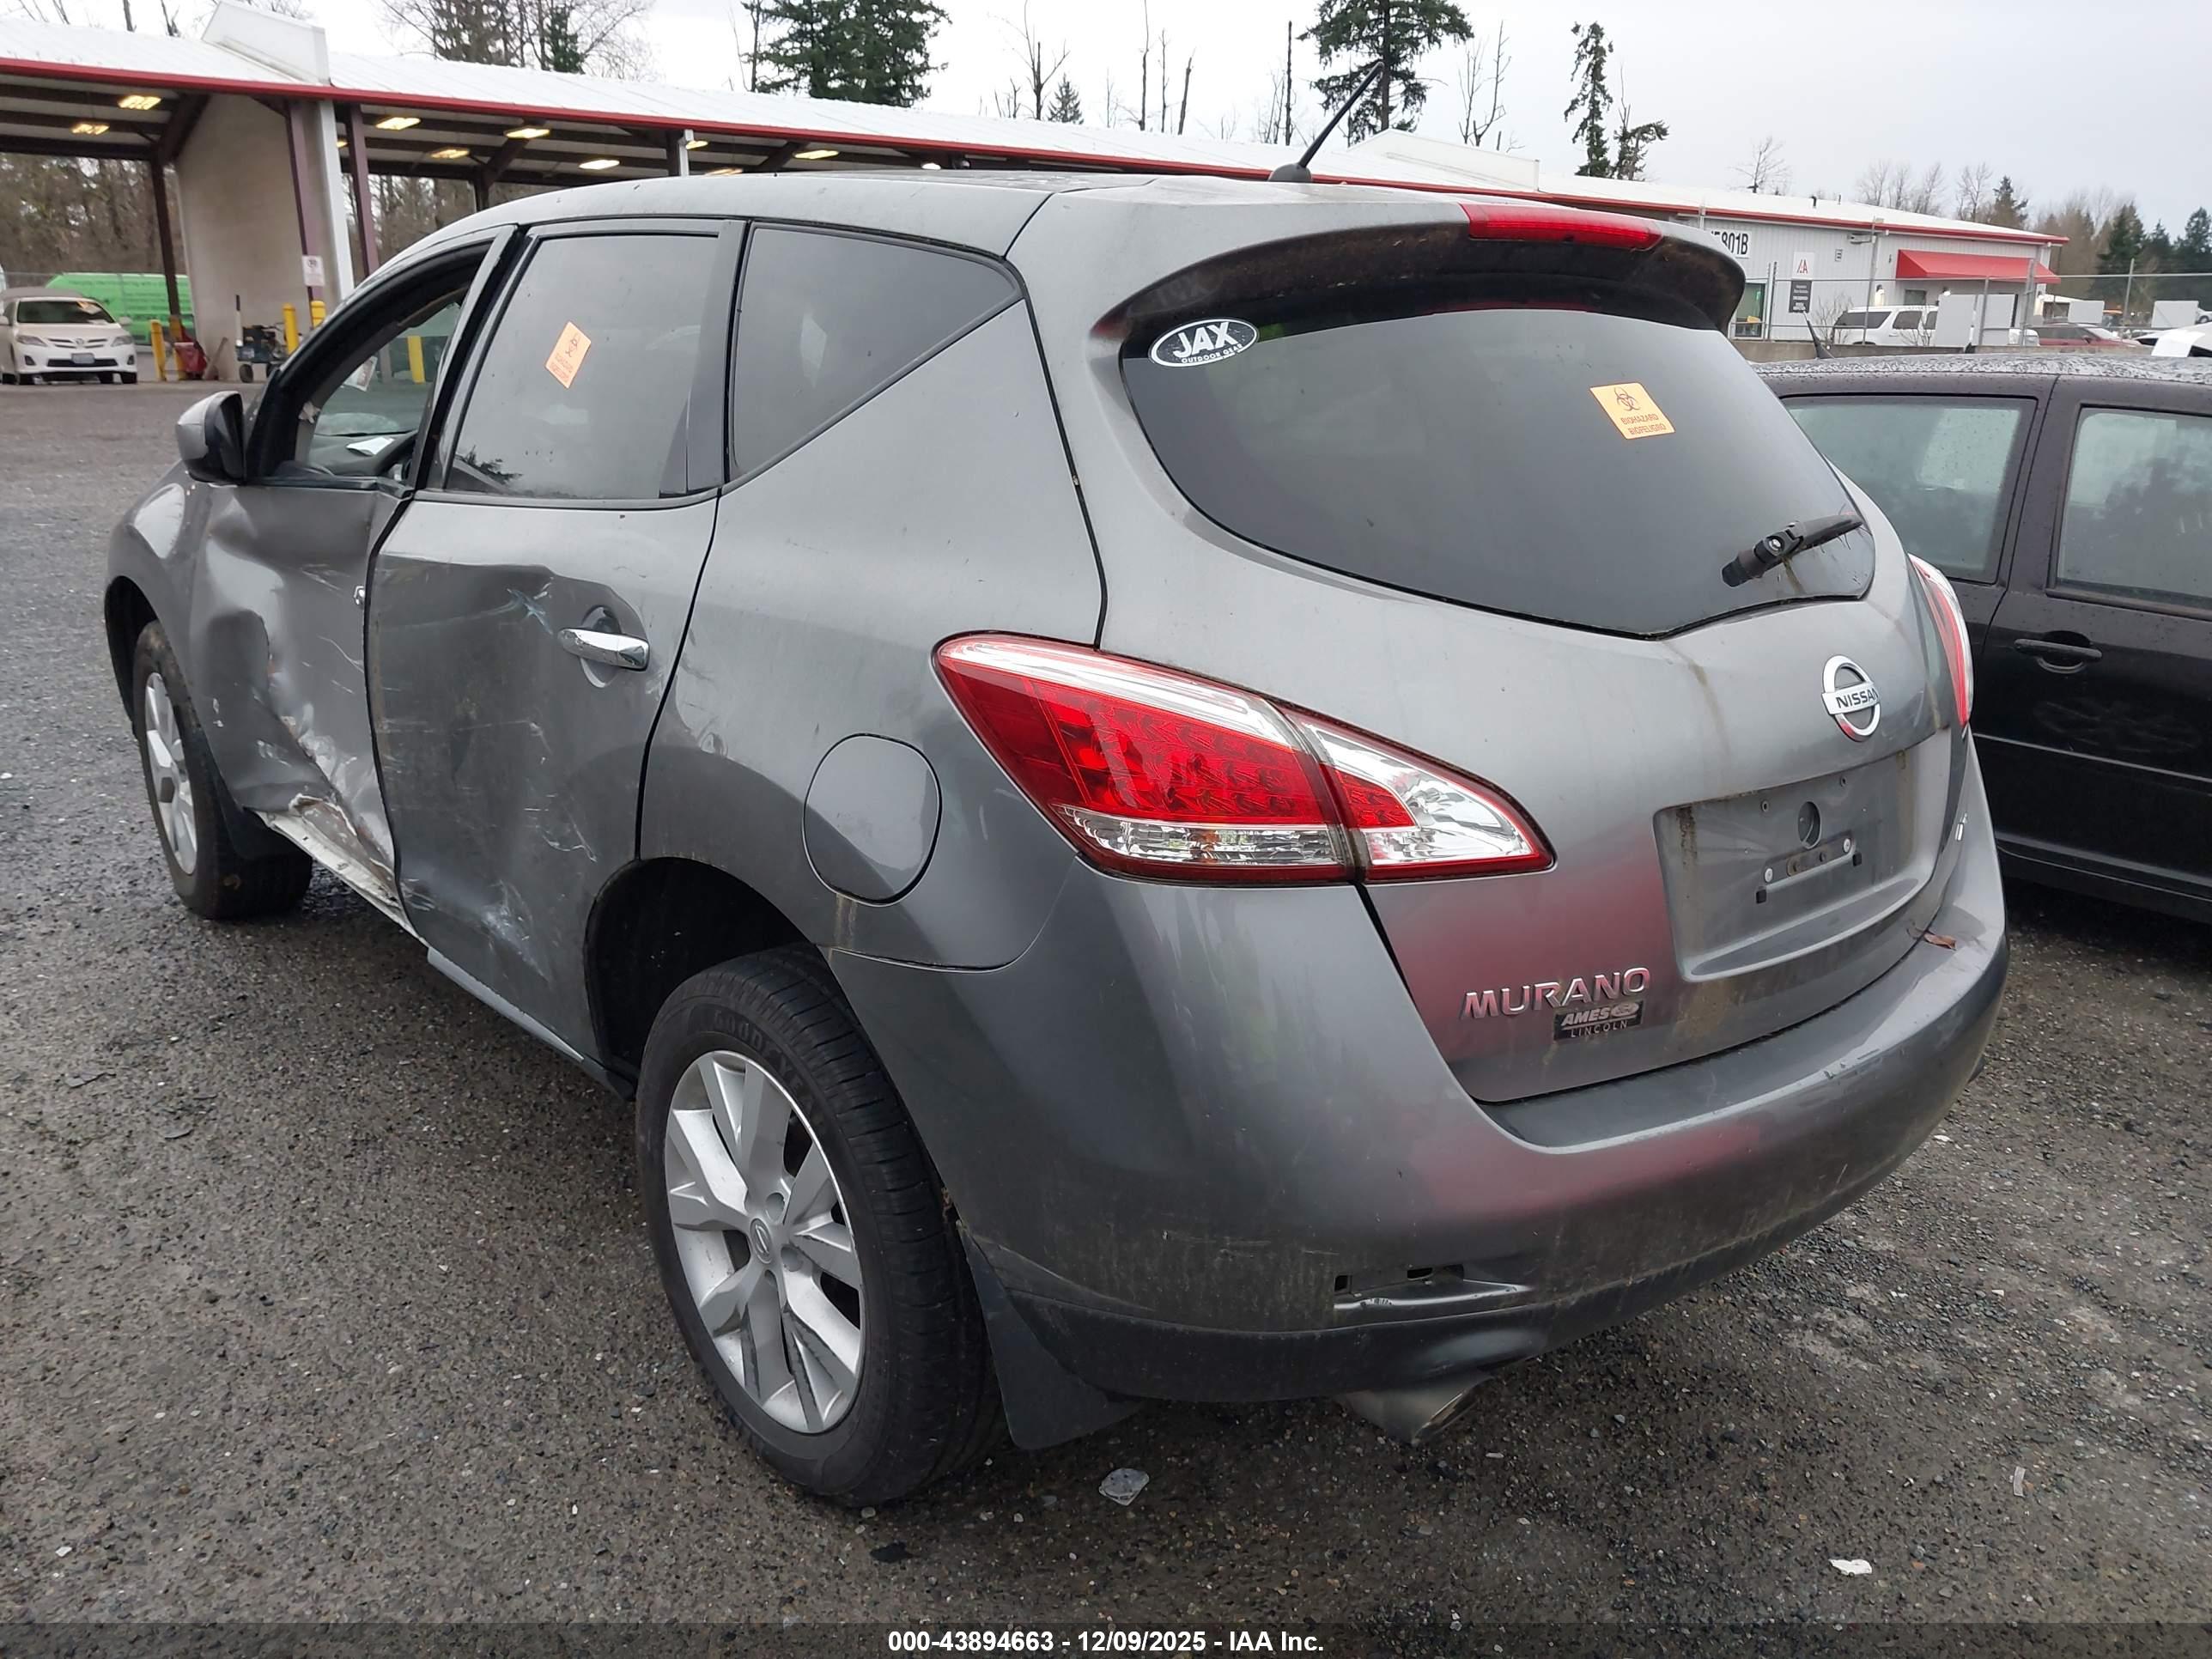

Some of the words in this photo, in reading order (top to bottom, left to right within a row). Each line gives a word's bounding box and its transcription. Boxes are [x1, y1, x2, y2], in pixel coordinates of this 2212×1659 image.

[1173, 321, 1238, 358] JAX
[1181, 352, 1221, 364] OUTDOOR
[1223, 343, 1243, 355] GEAR
[1620, 413, 1659, 425] BIOHAZARD
[1835, 688, 1879, 708] NISSAN
[1461, 967, 1650, 1019] MURANO
[1561, 1006, 1611, 1027] AMES
[1571, 1019, 1628, 1038] LINCOLN
